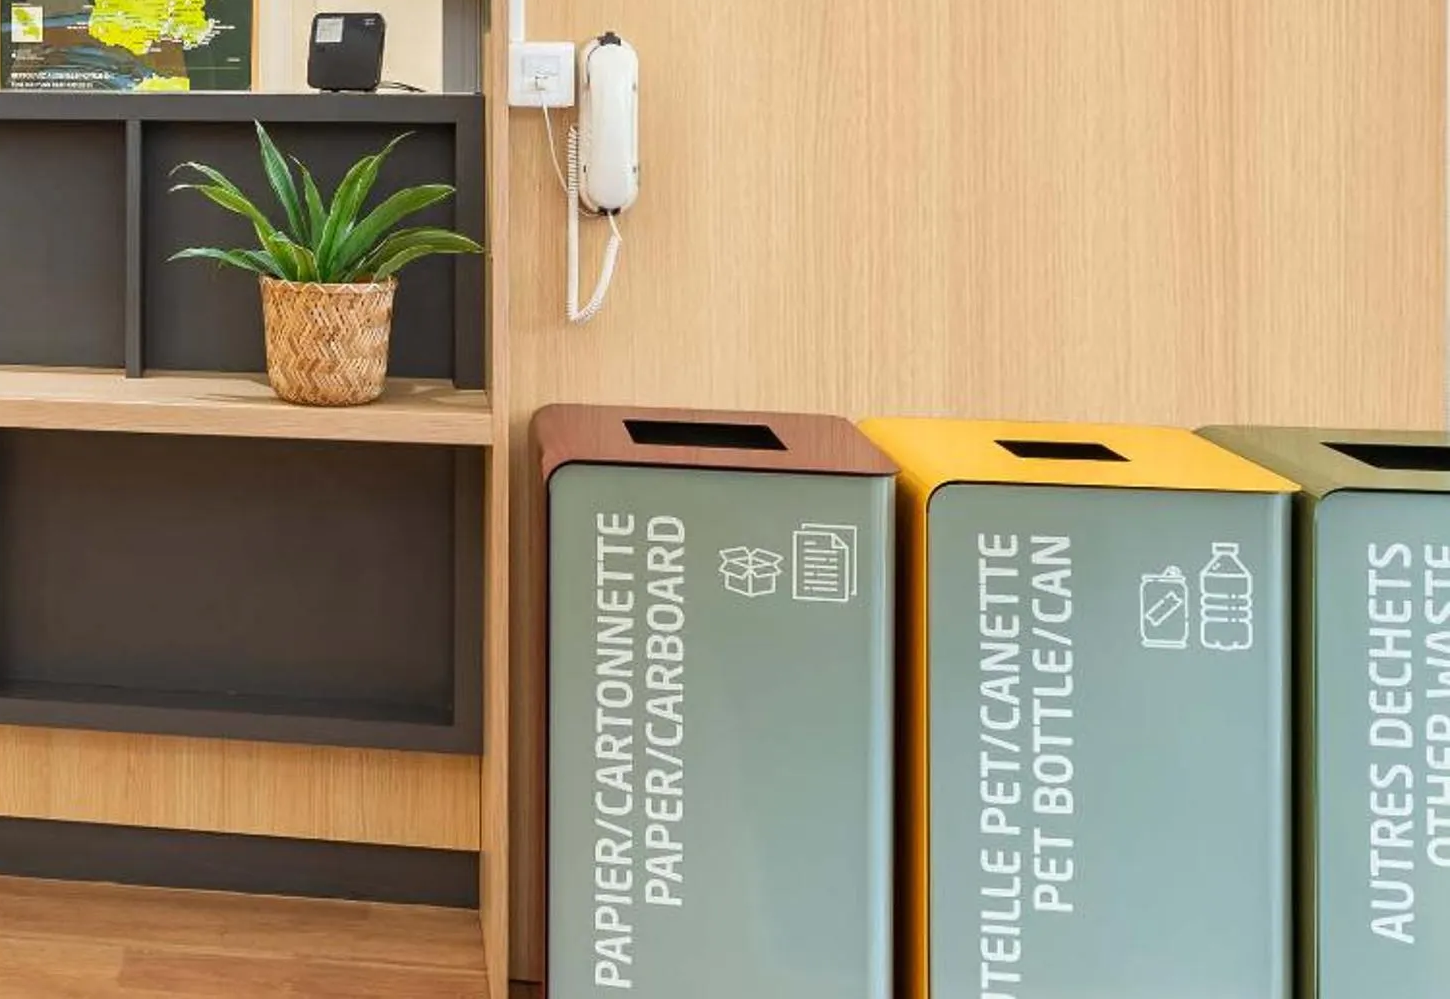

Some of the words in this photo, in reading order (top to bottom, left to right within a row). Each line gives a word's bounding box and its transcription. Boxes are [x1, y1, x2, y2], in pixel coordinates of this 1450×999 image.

[595, 513, 634, 988] PAPIER/CARTONNETTE
[645, 515, 685, 906] PAPER/CARBOARD
[978, 533, 1022, 835] PET/CANETTE
[1030, 535, 1074, 815] BOTTLE/CAN
[1368, 542, 1413, 748] DECHETS
[1033, 828, 1074, 912] PET
[1368, 763, 1415, 944] AUTRES
